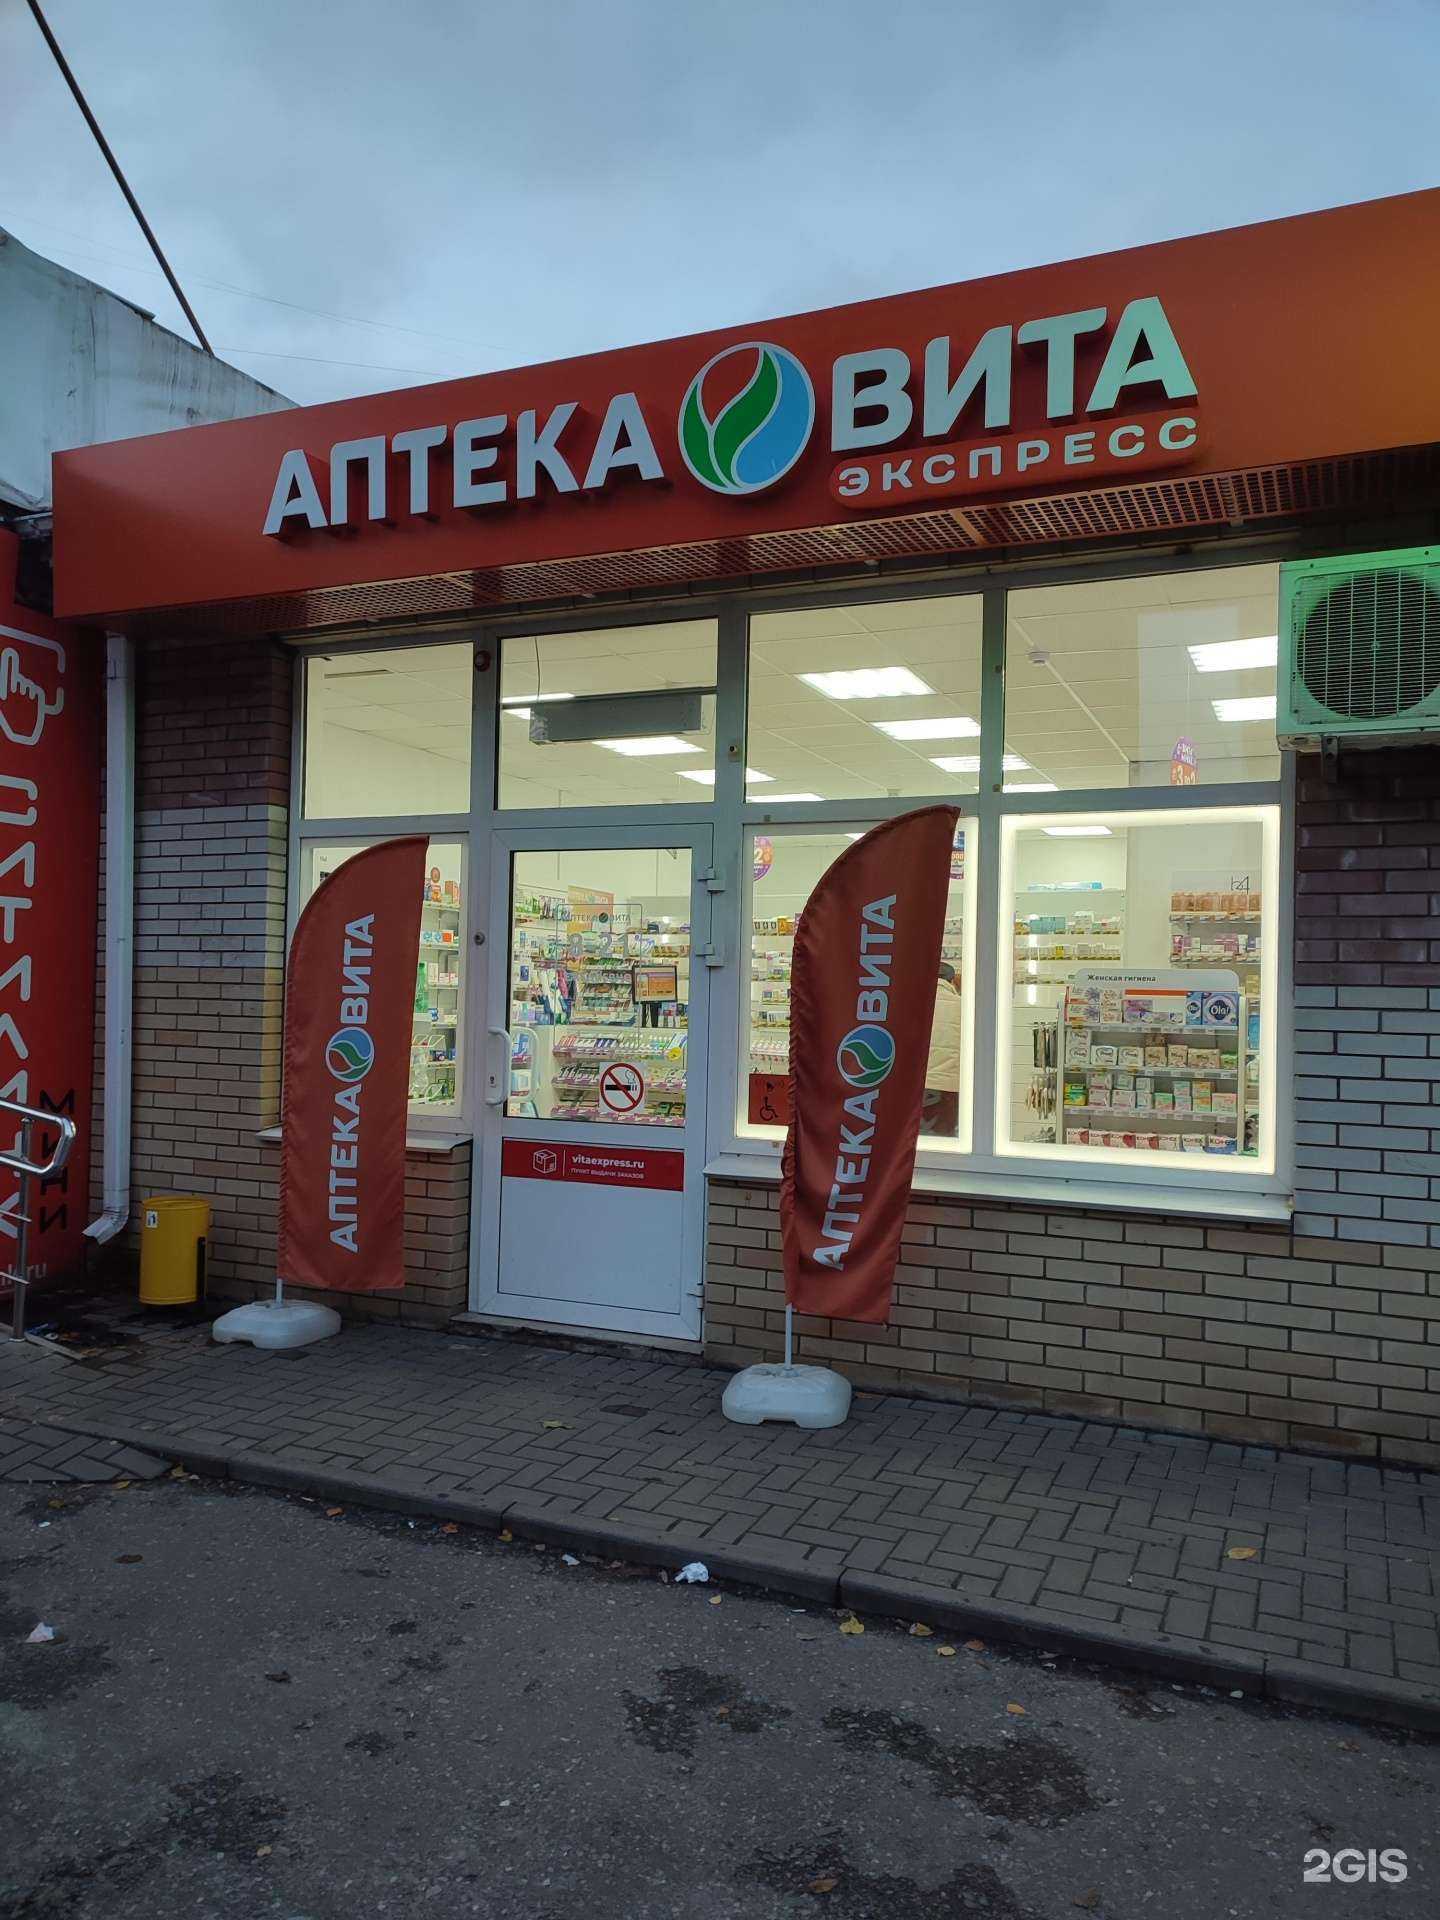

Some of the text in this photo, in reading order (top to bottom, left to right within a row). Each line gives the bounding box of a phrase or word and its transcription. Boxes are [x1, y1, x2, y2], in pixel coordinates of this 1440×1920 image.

[262, 296, 1199, 535] АПТЕКА ВИТА
[838, 417, 1198, 496] ЭКСПРЕСС
[340, 912, 375, 1025] ВИТА
[857, 894, 897, 1022] ВИТА
[1087, 974, 1156, 983] Женская гигиена
[329, 1083, 362, 1254] АПТЕКА
[571, 1154, 645, 1168] vitaexpress.ru
[812, 1088, 880, 1271] АПТЕКА
